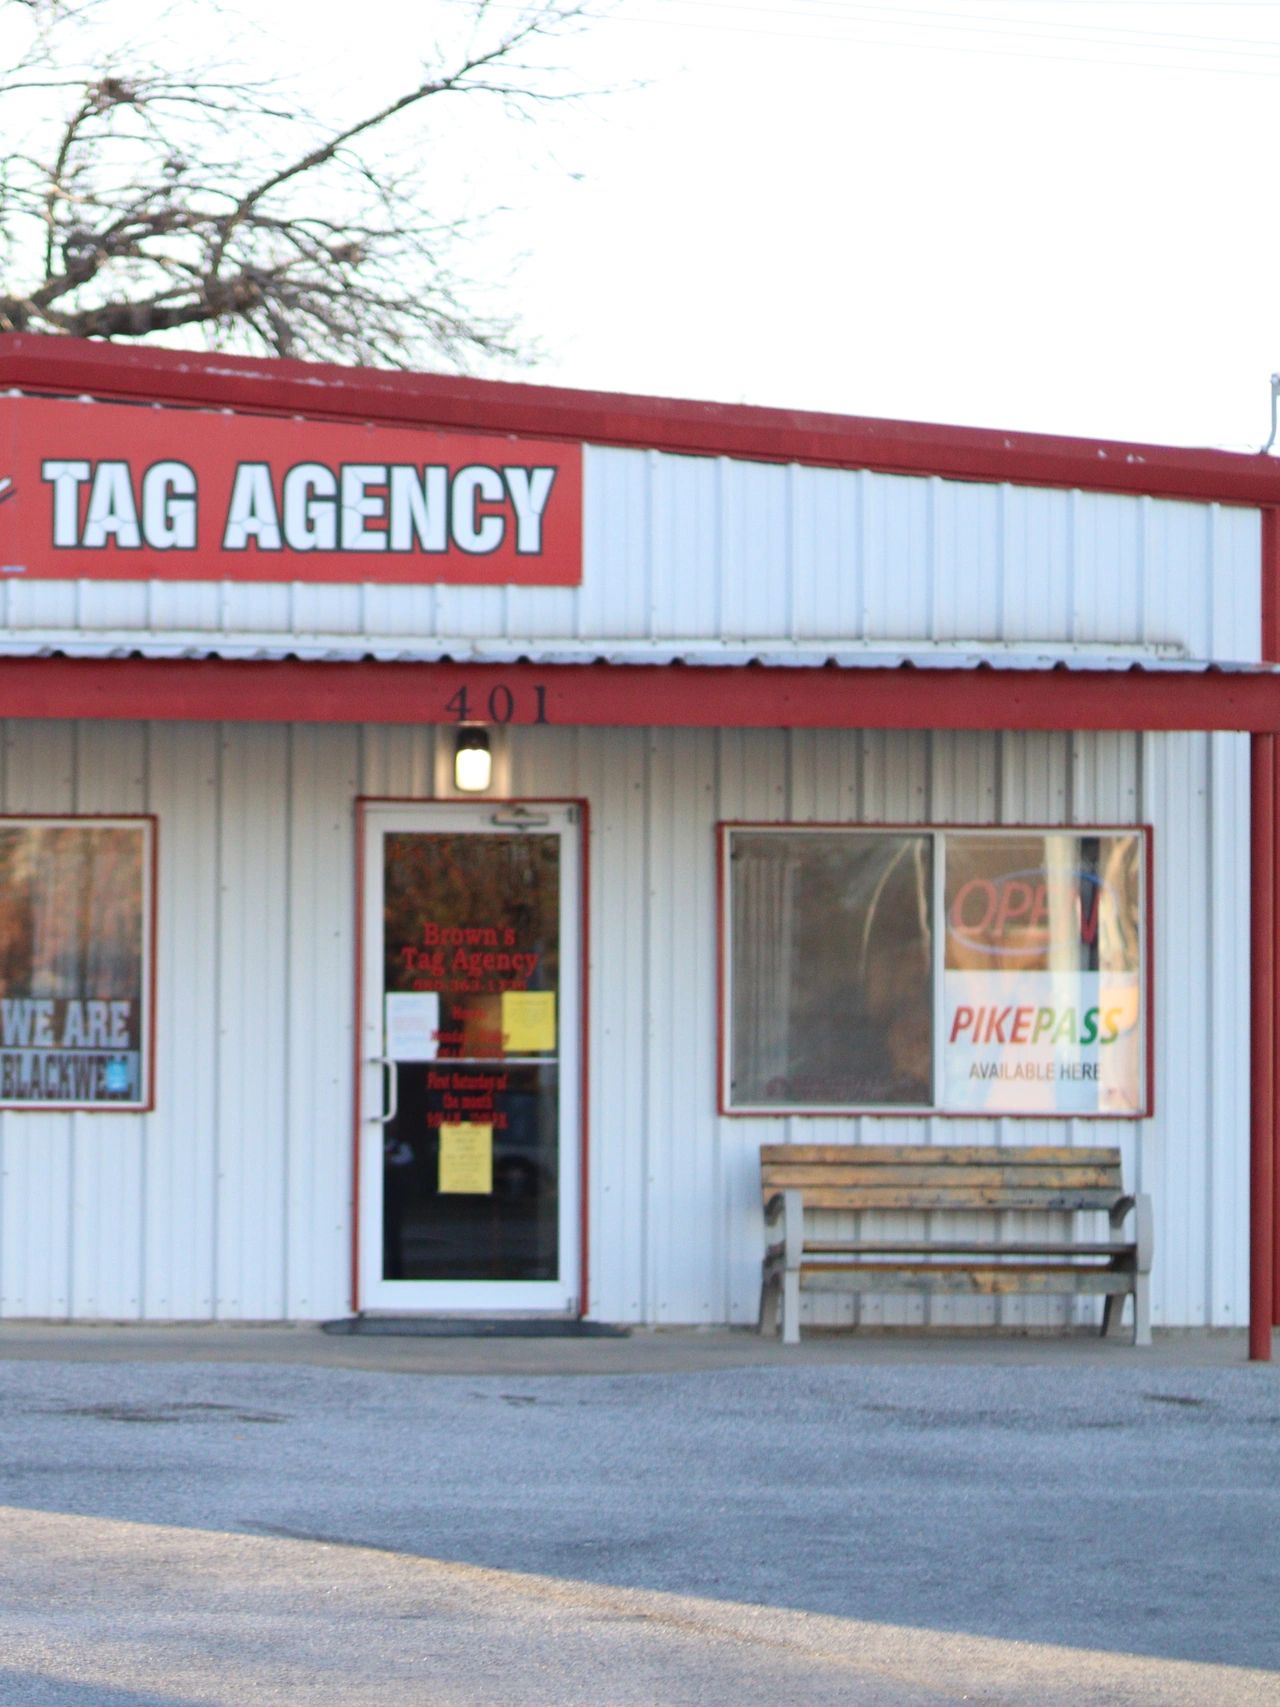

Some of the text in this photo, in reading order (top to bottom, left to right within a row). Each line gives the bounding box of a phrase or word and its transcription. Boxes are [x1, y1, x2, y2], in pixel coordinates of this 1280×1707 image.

[41, 459, 199, 551] TAG
[222, 460, 559, 556] AGENCY
[445, 685, 550, 724] 401
[423, 921, 517, 946] Brown's
[400, 946, 541, 978] Tag Agency
[0, 998, 131, 1049] WE ARE
[949, 1005, 1123, 1046] PIKEPASS
[969, 1062, 1101, 1082] AVAILABLE HERE
